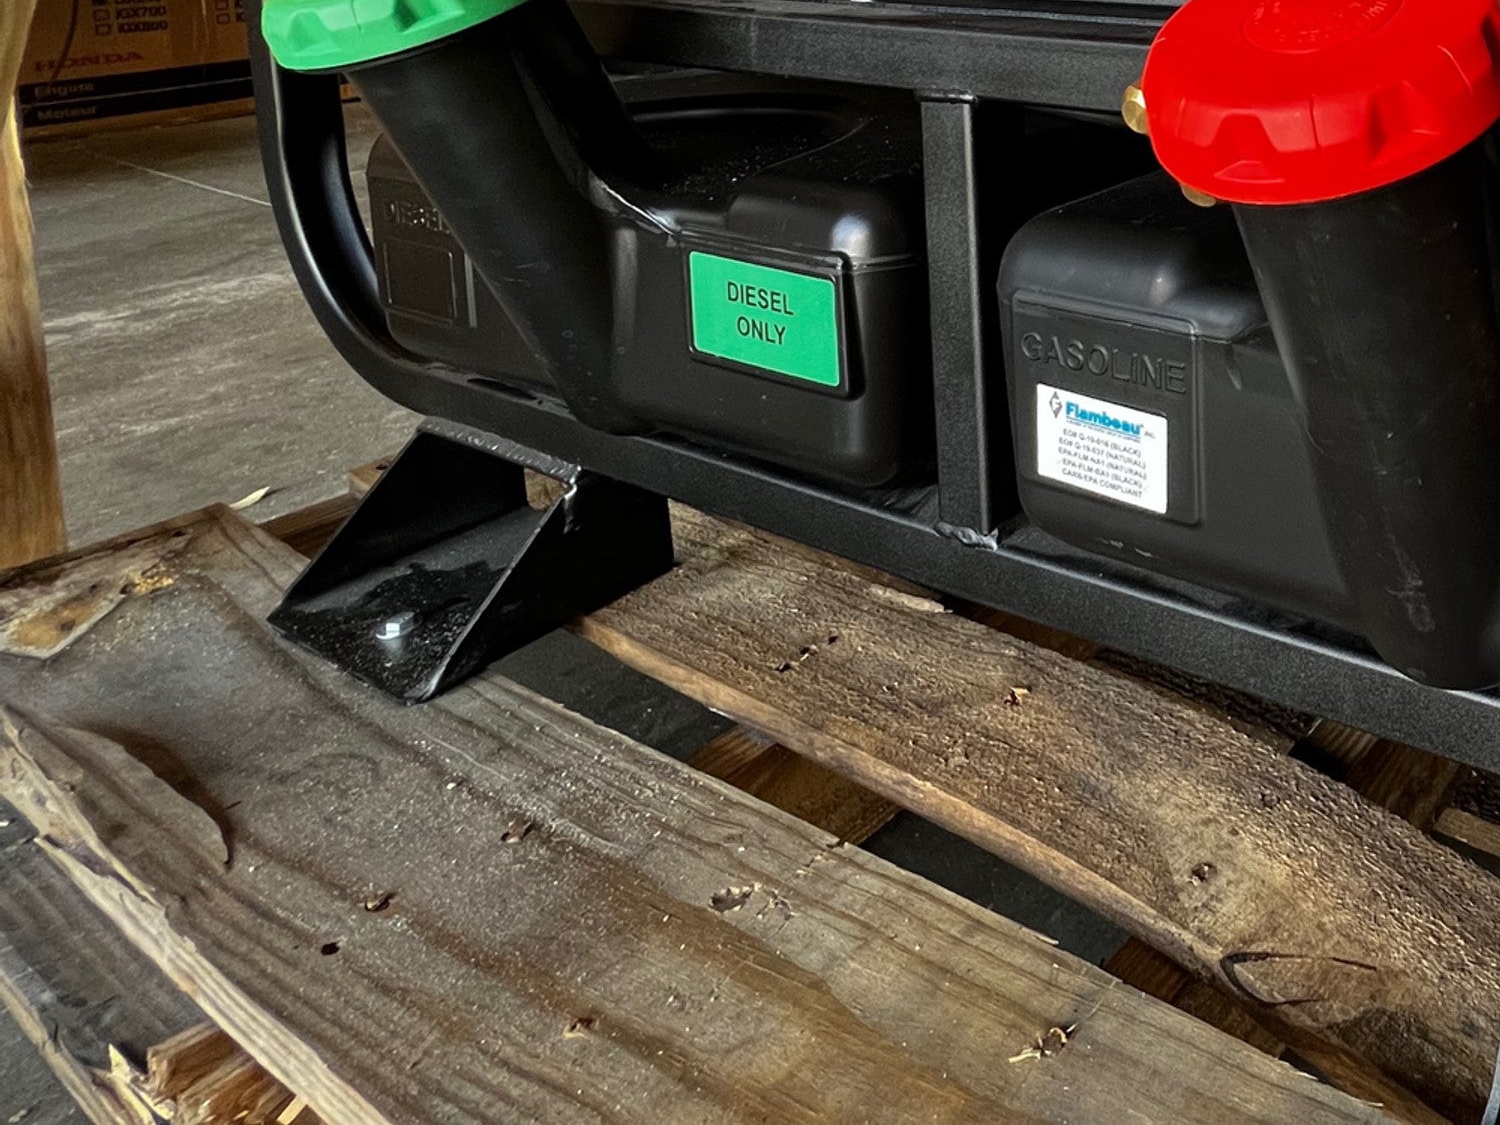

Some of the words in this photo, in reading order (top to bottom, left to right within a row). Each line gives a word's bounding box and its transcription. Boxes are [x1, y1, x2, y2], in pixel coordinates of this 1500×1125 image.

[726, 280, 795, 317] DIESEL
[736, 315, 787, 346] ONLY
[1020, 330, 1187, 395] GASOLINE
[1065, 400, 1142, 436] Flambeau
